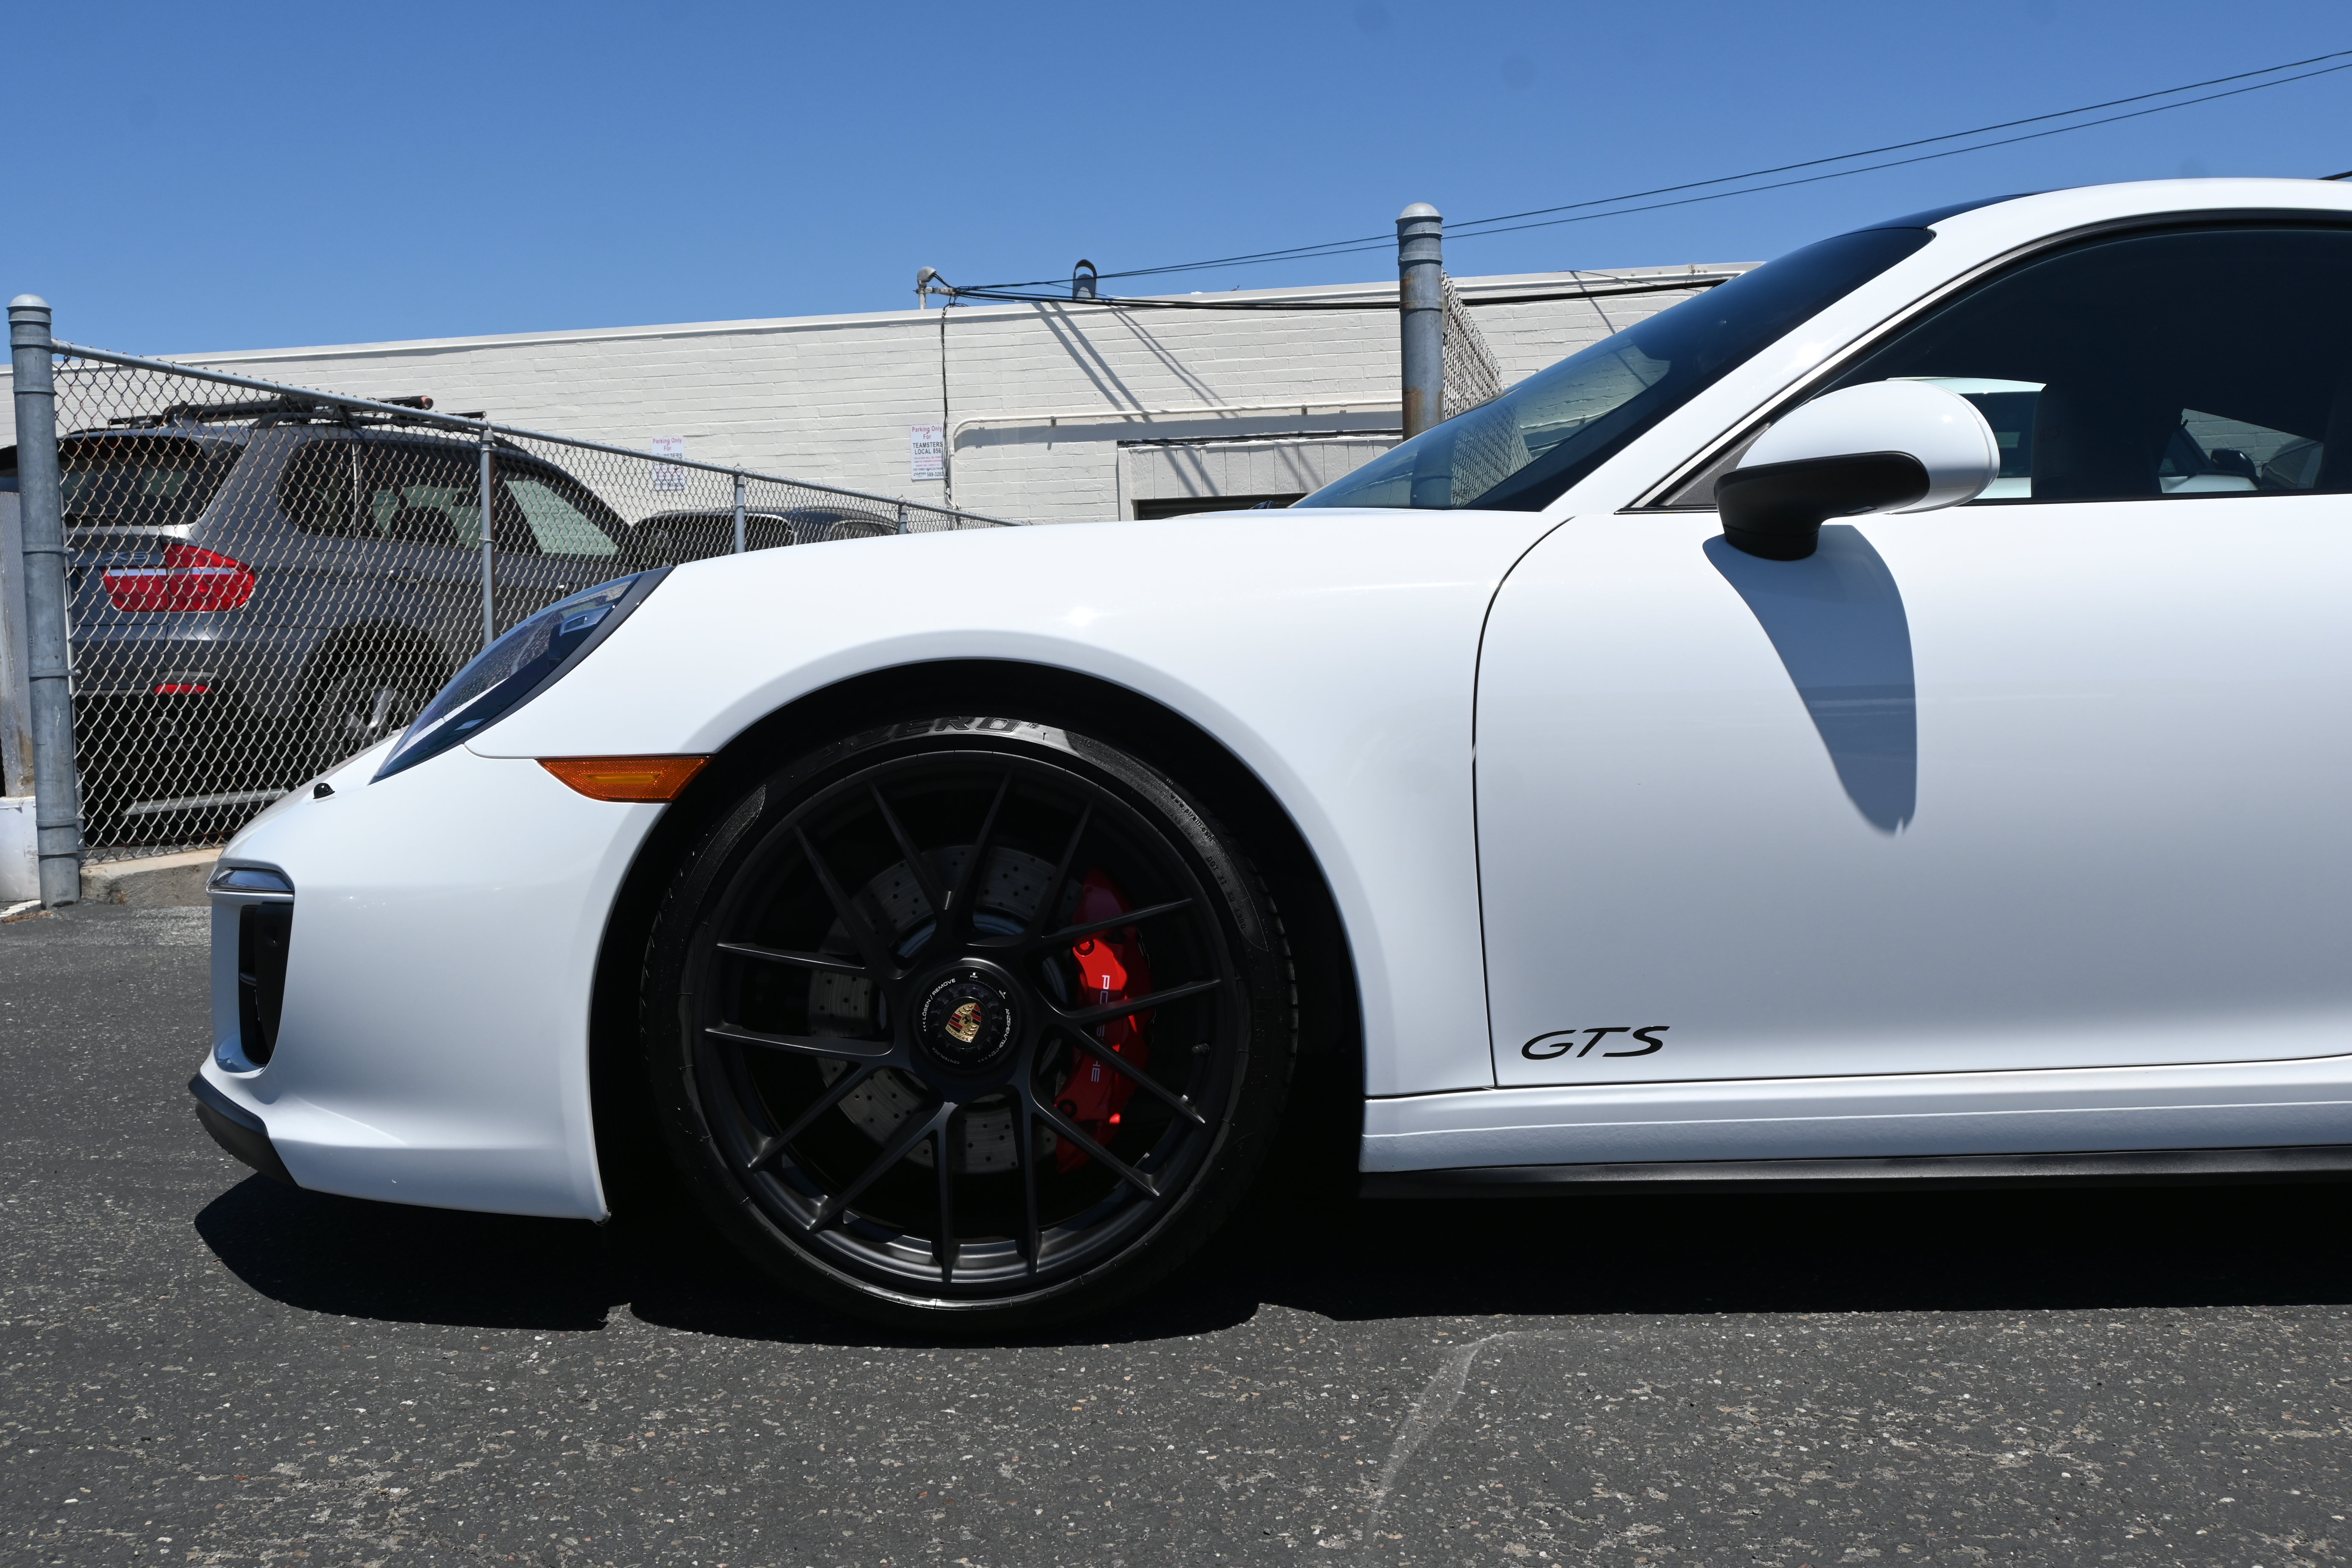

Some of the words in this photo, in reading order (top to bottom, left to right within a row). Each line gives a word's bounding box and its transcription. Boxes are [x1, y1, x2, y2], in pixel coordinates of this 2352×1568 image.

[853, 716, 1022, 750] ZERO
[932, 978, 956, 996] REMOVE
[1522, 1026, 1671, 1060] GTS
